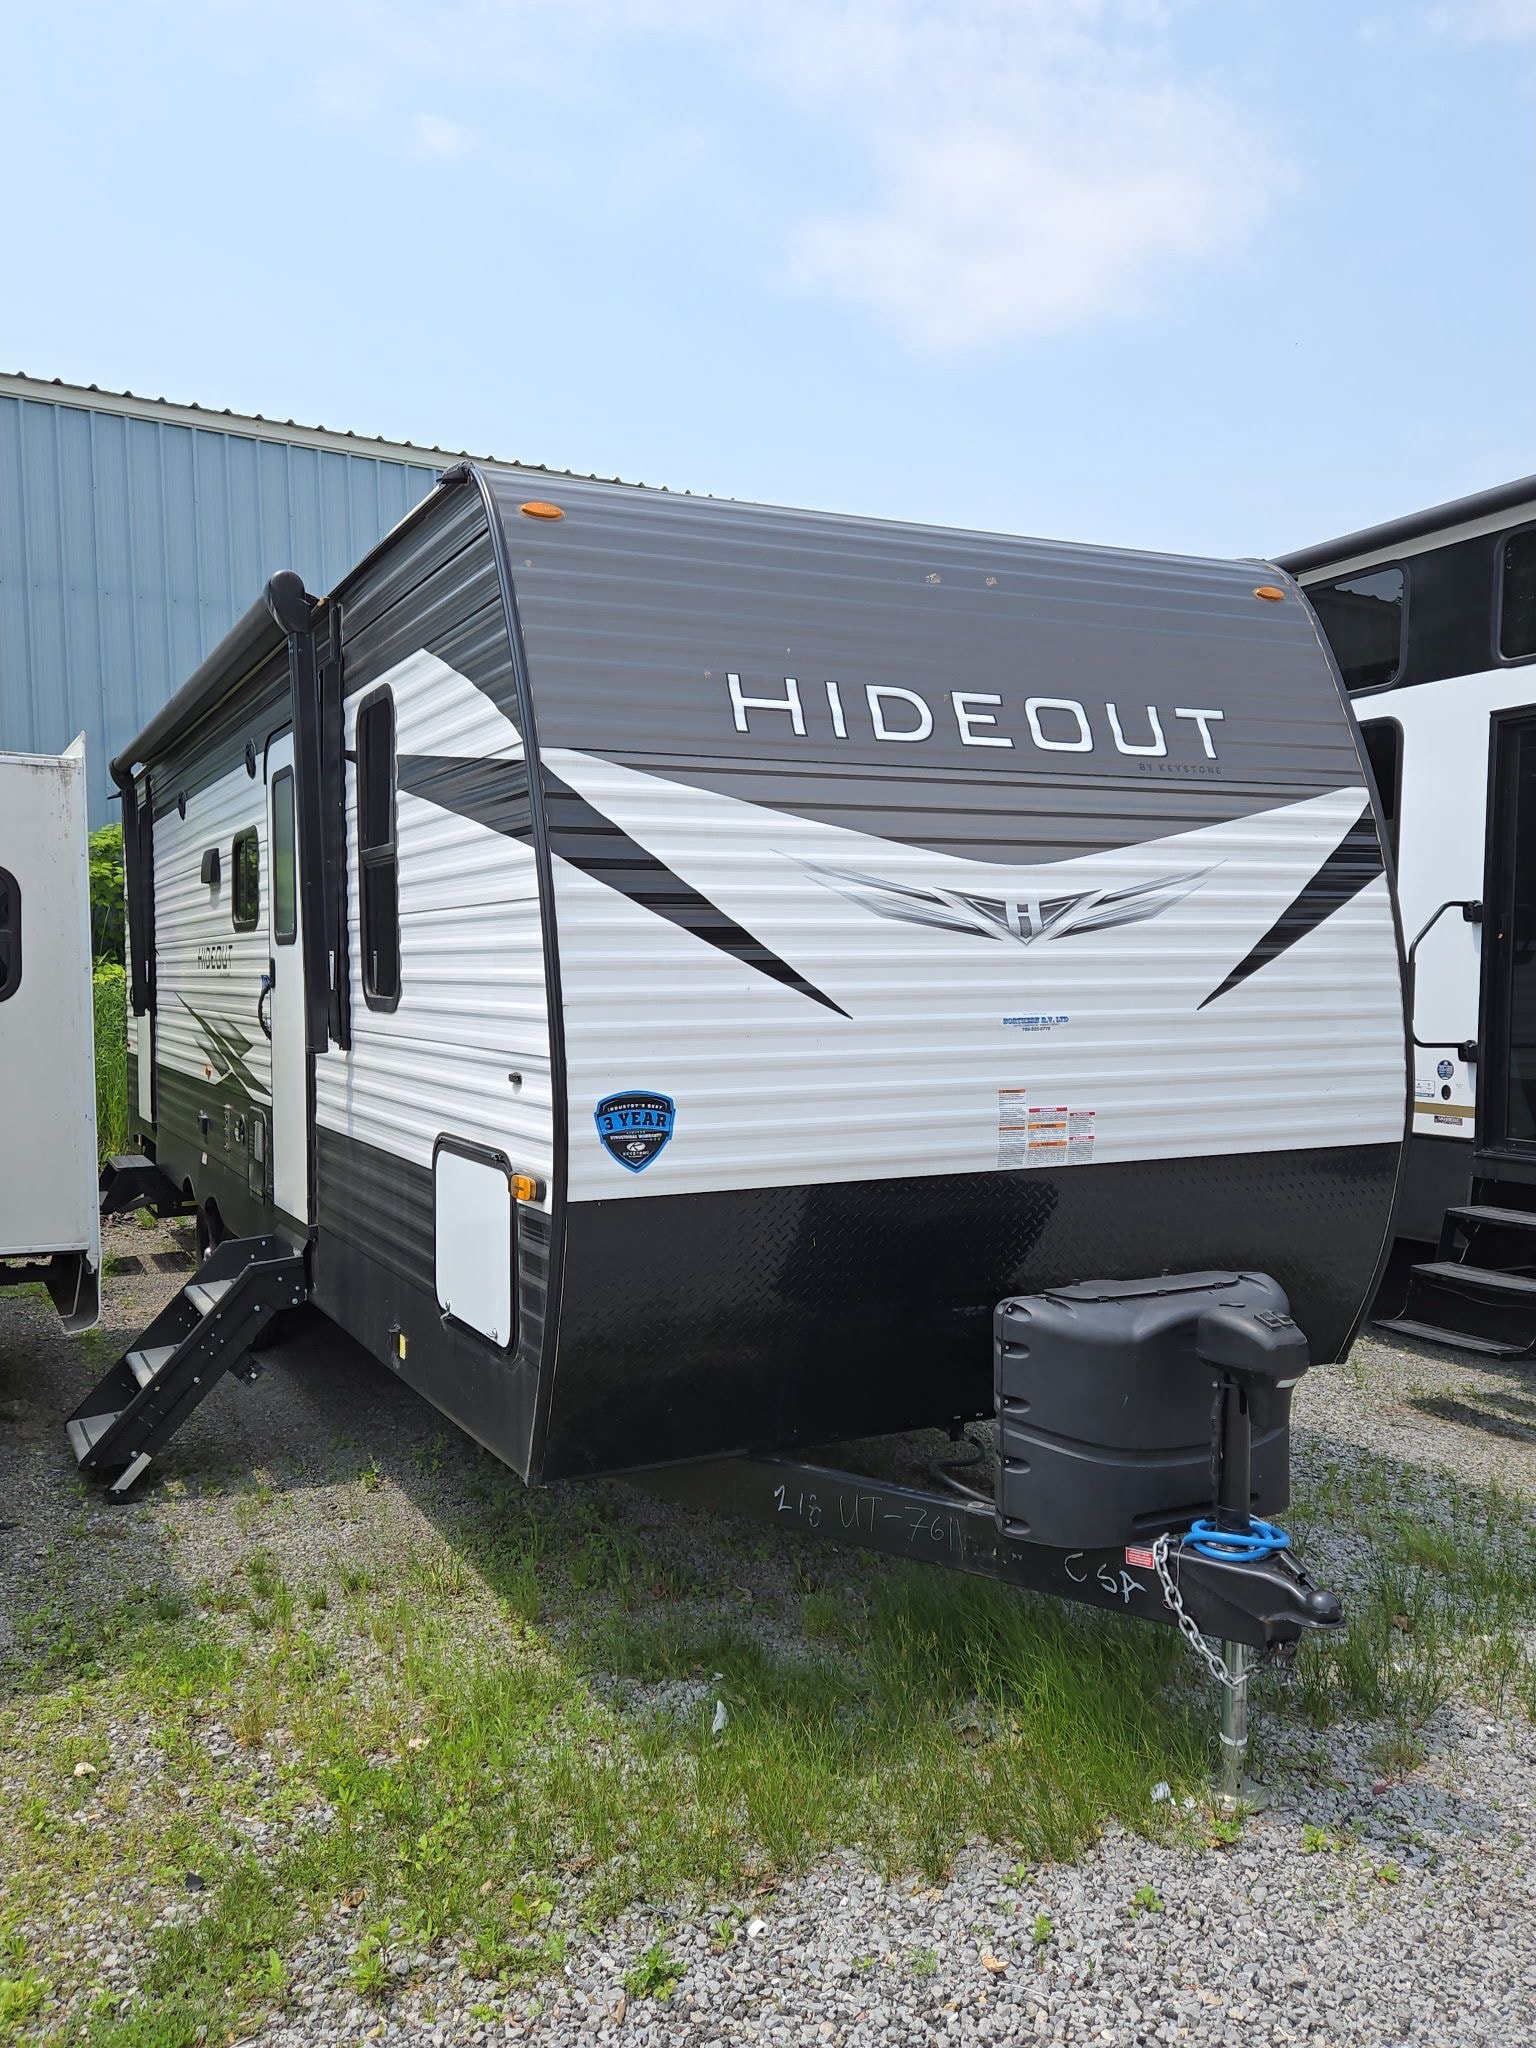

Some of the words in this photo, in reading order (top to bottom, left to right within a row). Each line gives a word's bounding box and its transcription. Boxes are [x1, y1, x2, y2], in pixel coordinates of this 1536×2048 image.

[725, 672, 1225, 760] HIDEOUT
[1138, 763, 1153, 772] BY
[1158, 764, 1222, 775] KEYSTONE
[198, 945, 233, 969] HIDEOUT
[603, 1117, 614, 1130] 3
[618, 1112, 667, 1127] YEAR
[773, 1484, 823, 1529] 218
